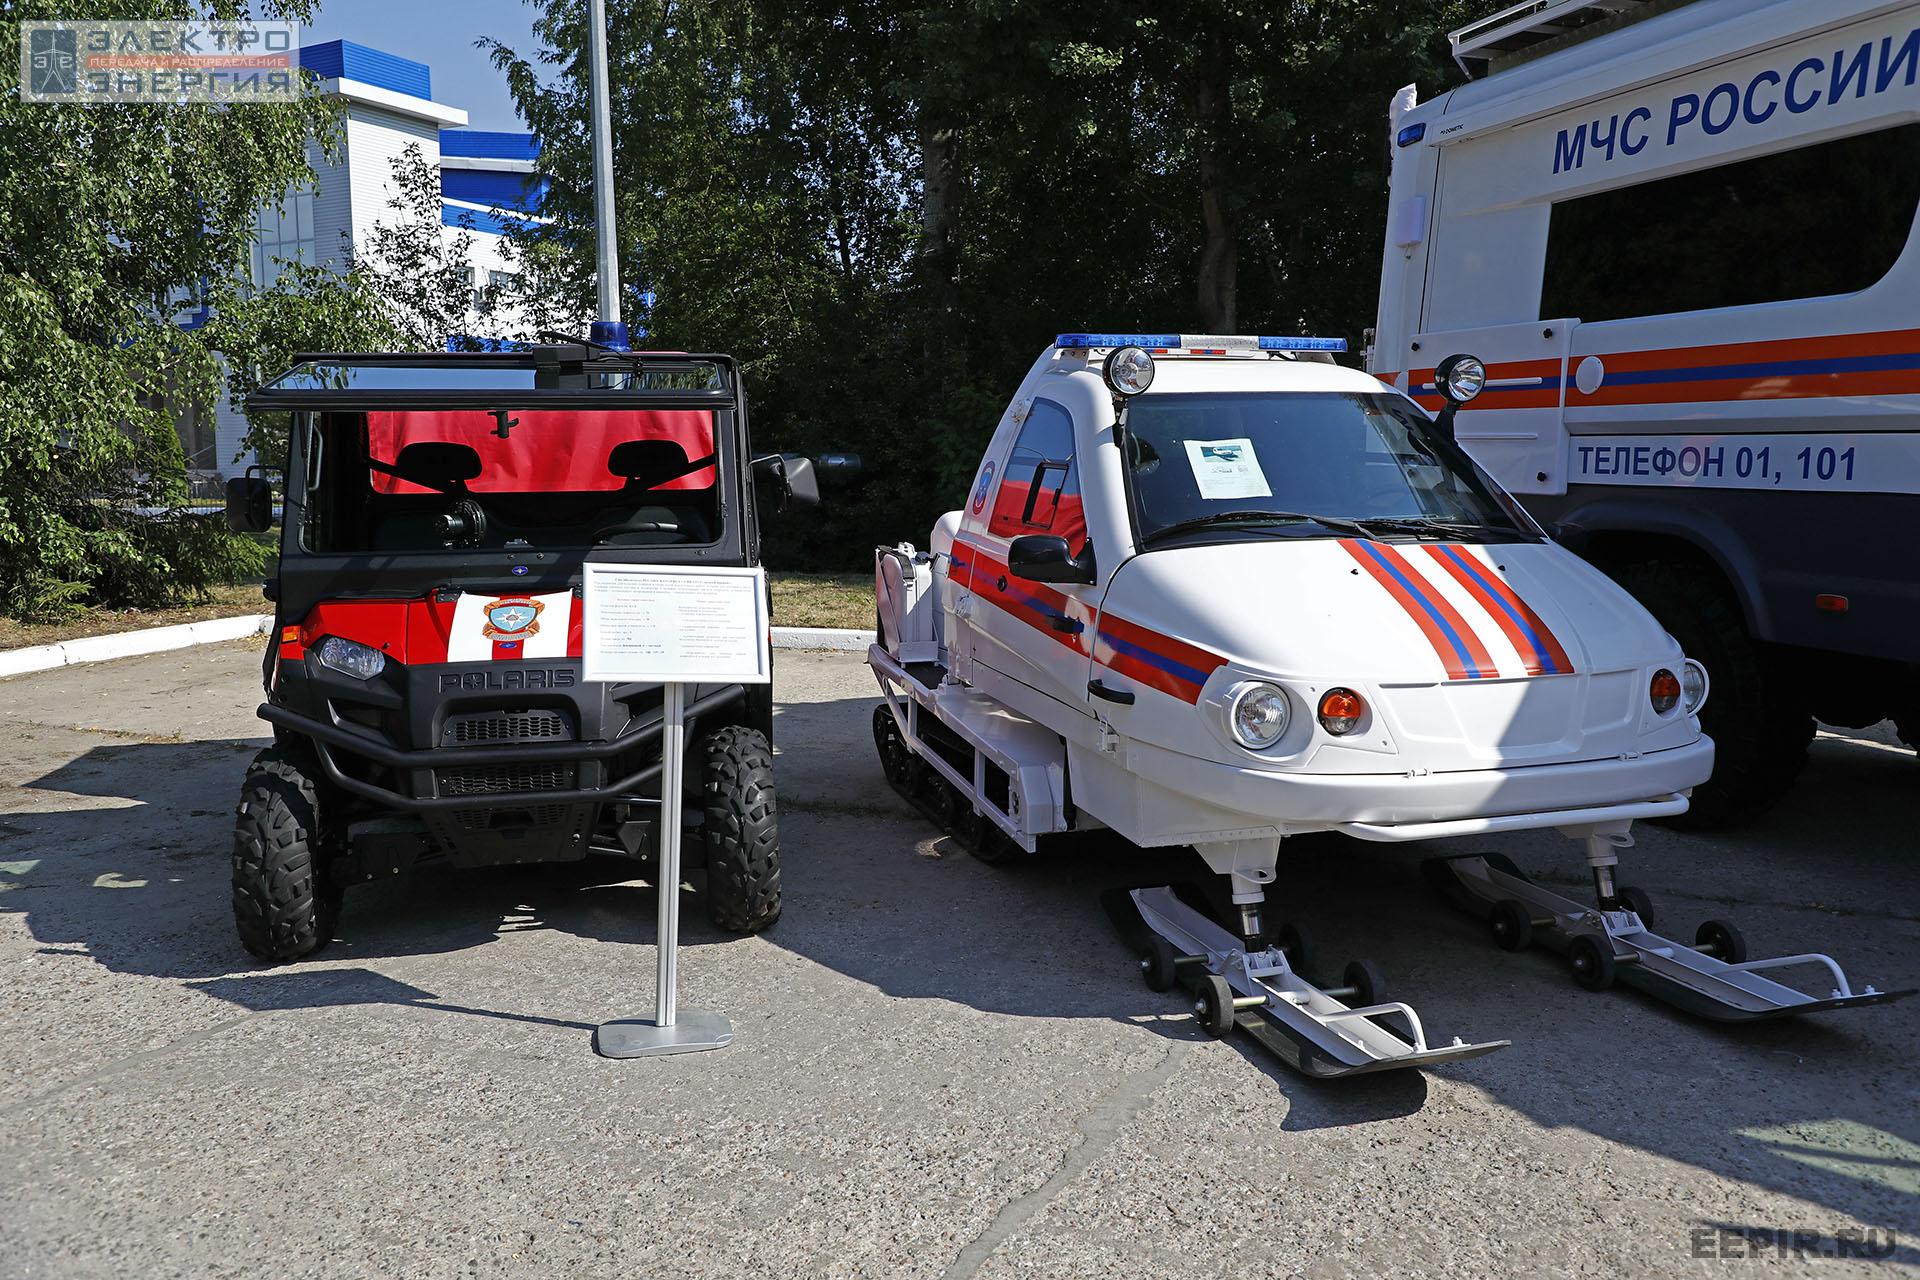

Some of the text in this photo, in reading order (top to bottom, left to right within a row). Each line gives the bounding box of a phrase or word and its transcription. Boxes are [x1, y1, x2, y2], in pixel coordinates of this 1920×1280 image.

[1552, 28, 1920, 174] МЧС РОССИИ
[1578, 446, 1856, 484] ТЕЛЕФОН 01, 101
[439, 669, 575, 693] POLARIS
